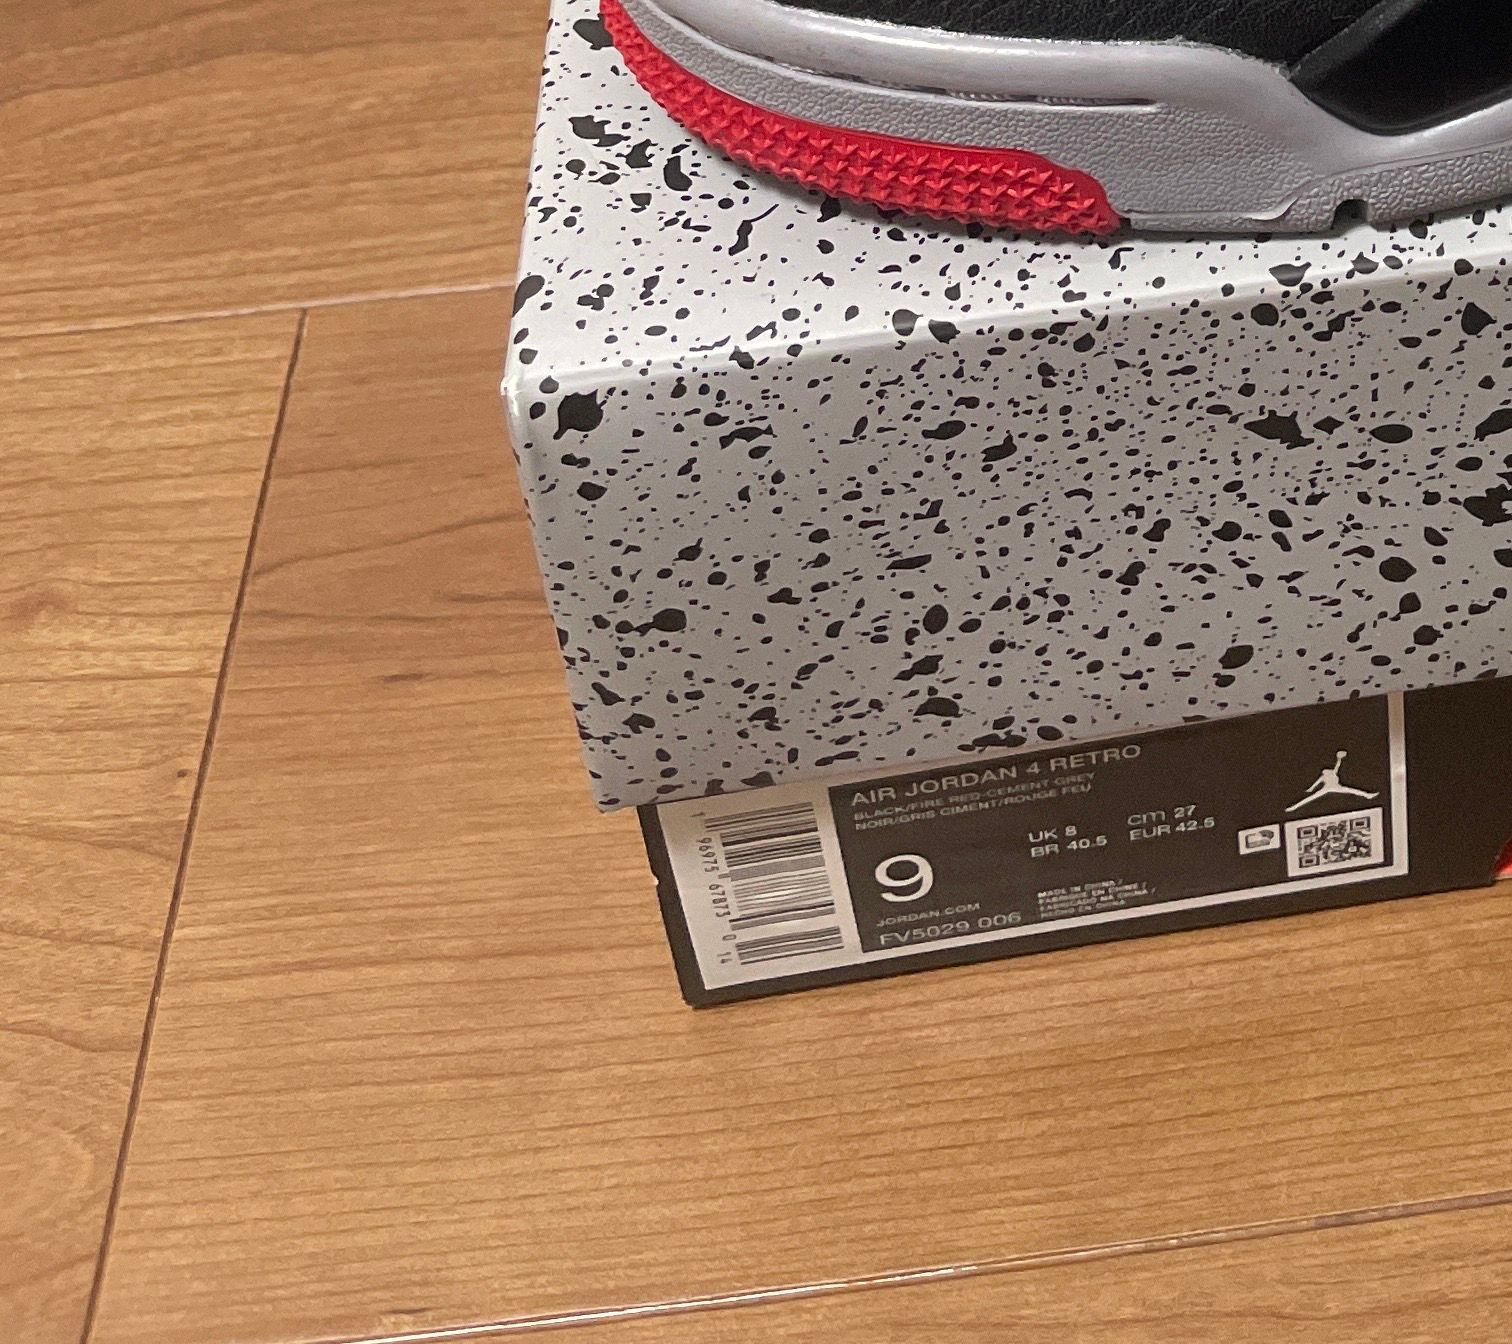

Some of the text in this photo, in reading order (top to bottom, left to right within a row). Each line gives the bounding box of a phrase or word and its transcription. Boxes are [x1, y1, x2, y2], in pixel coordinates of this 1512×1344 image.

[851, 744, 1142, 807] AIR JORDAN 4 RETRO
[1173, 804, 1197, 819] 27
[1028, 825, 1078, 843] UK 8
[1129, 824, 1171, 841] EUR
[1031, 835, 1108, 858] BR 40.5
[875, 854, 934, 903] 9
[876, 902, 981, 927] JORDAN.COM
[880, 912, 1022, 945] FV5029 006
